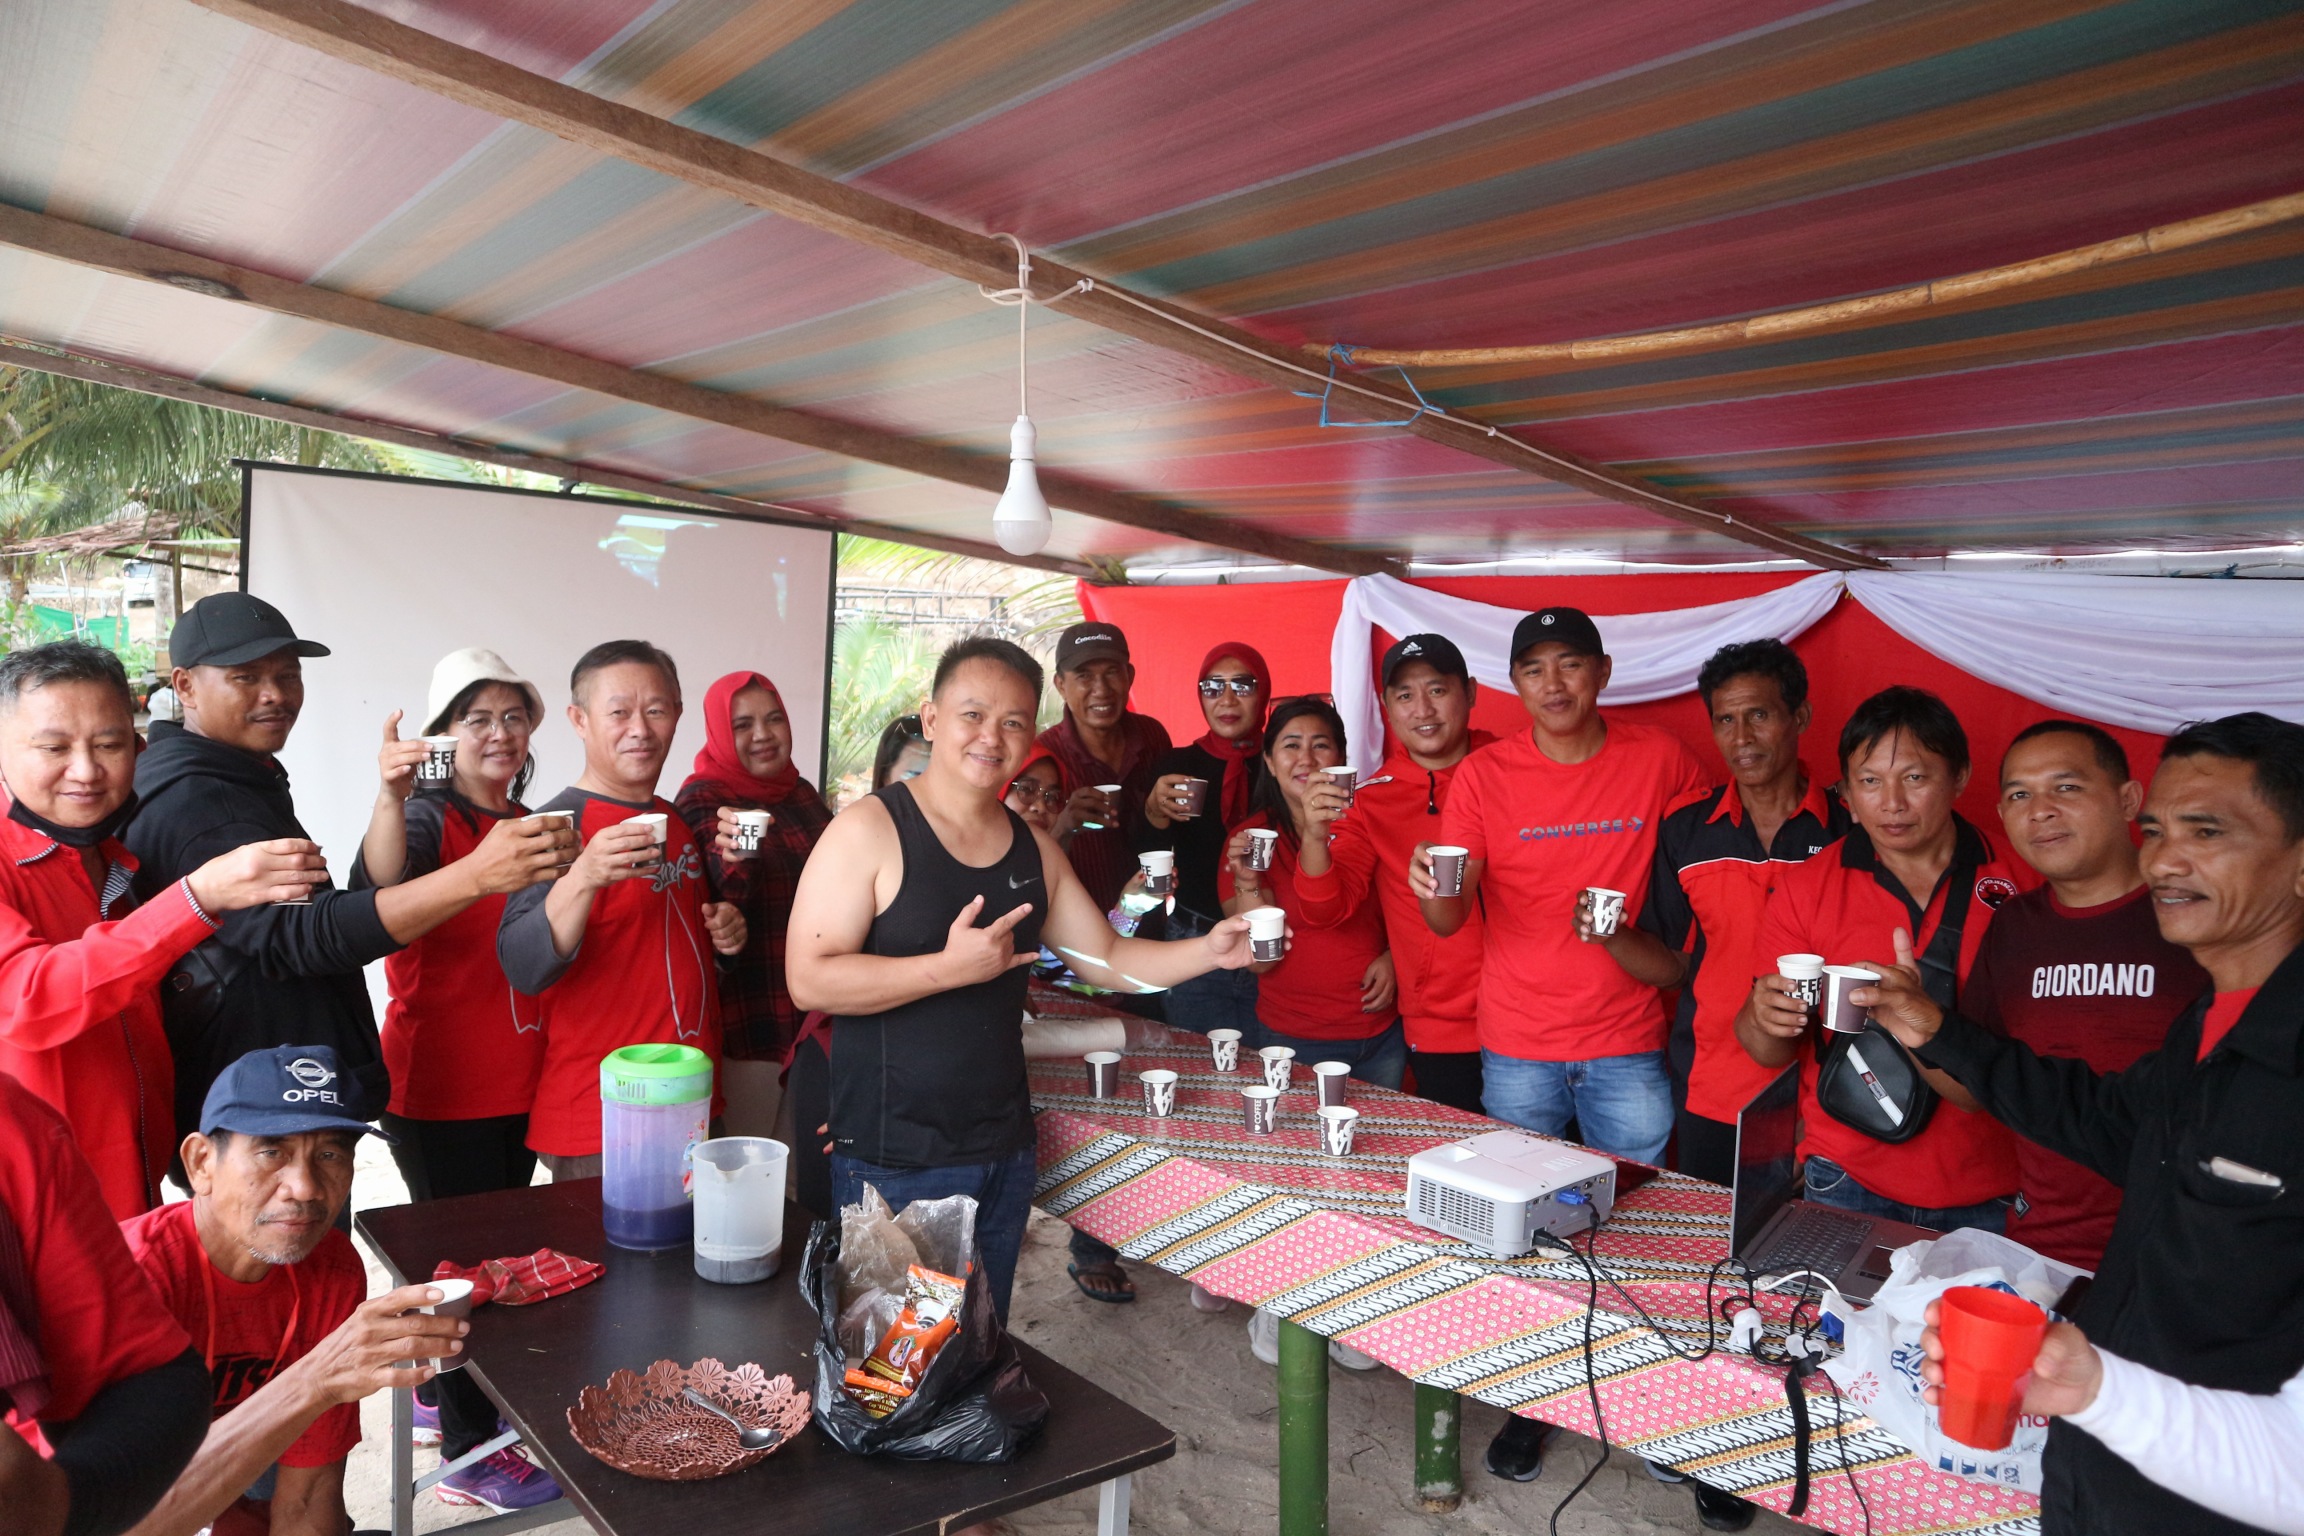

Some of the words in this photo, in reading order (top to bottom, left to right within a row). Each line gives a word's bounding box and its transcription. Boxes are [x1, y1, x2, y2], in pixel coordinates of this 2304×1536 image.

[1519, 819, 1624, 841] CONVERSE
[2031, 963, 2155, 999] GIORDANO
[282, 1089, 345, 1107] OPEL
[1254, 1098, 1262, 1123] COFFEE
